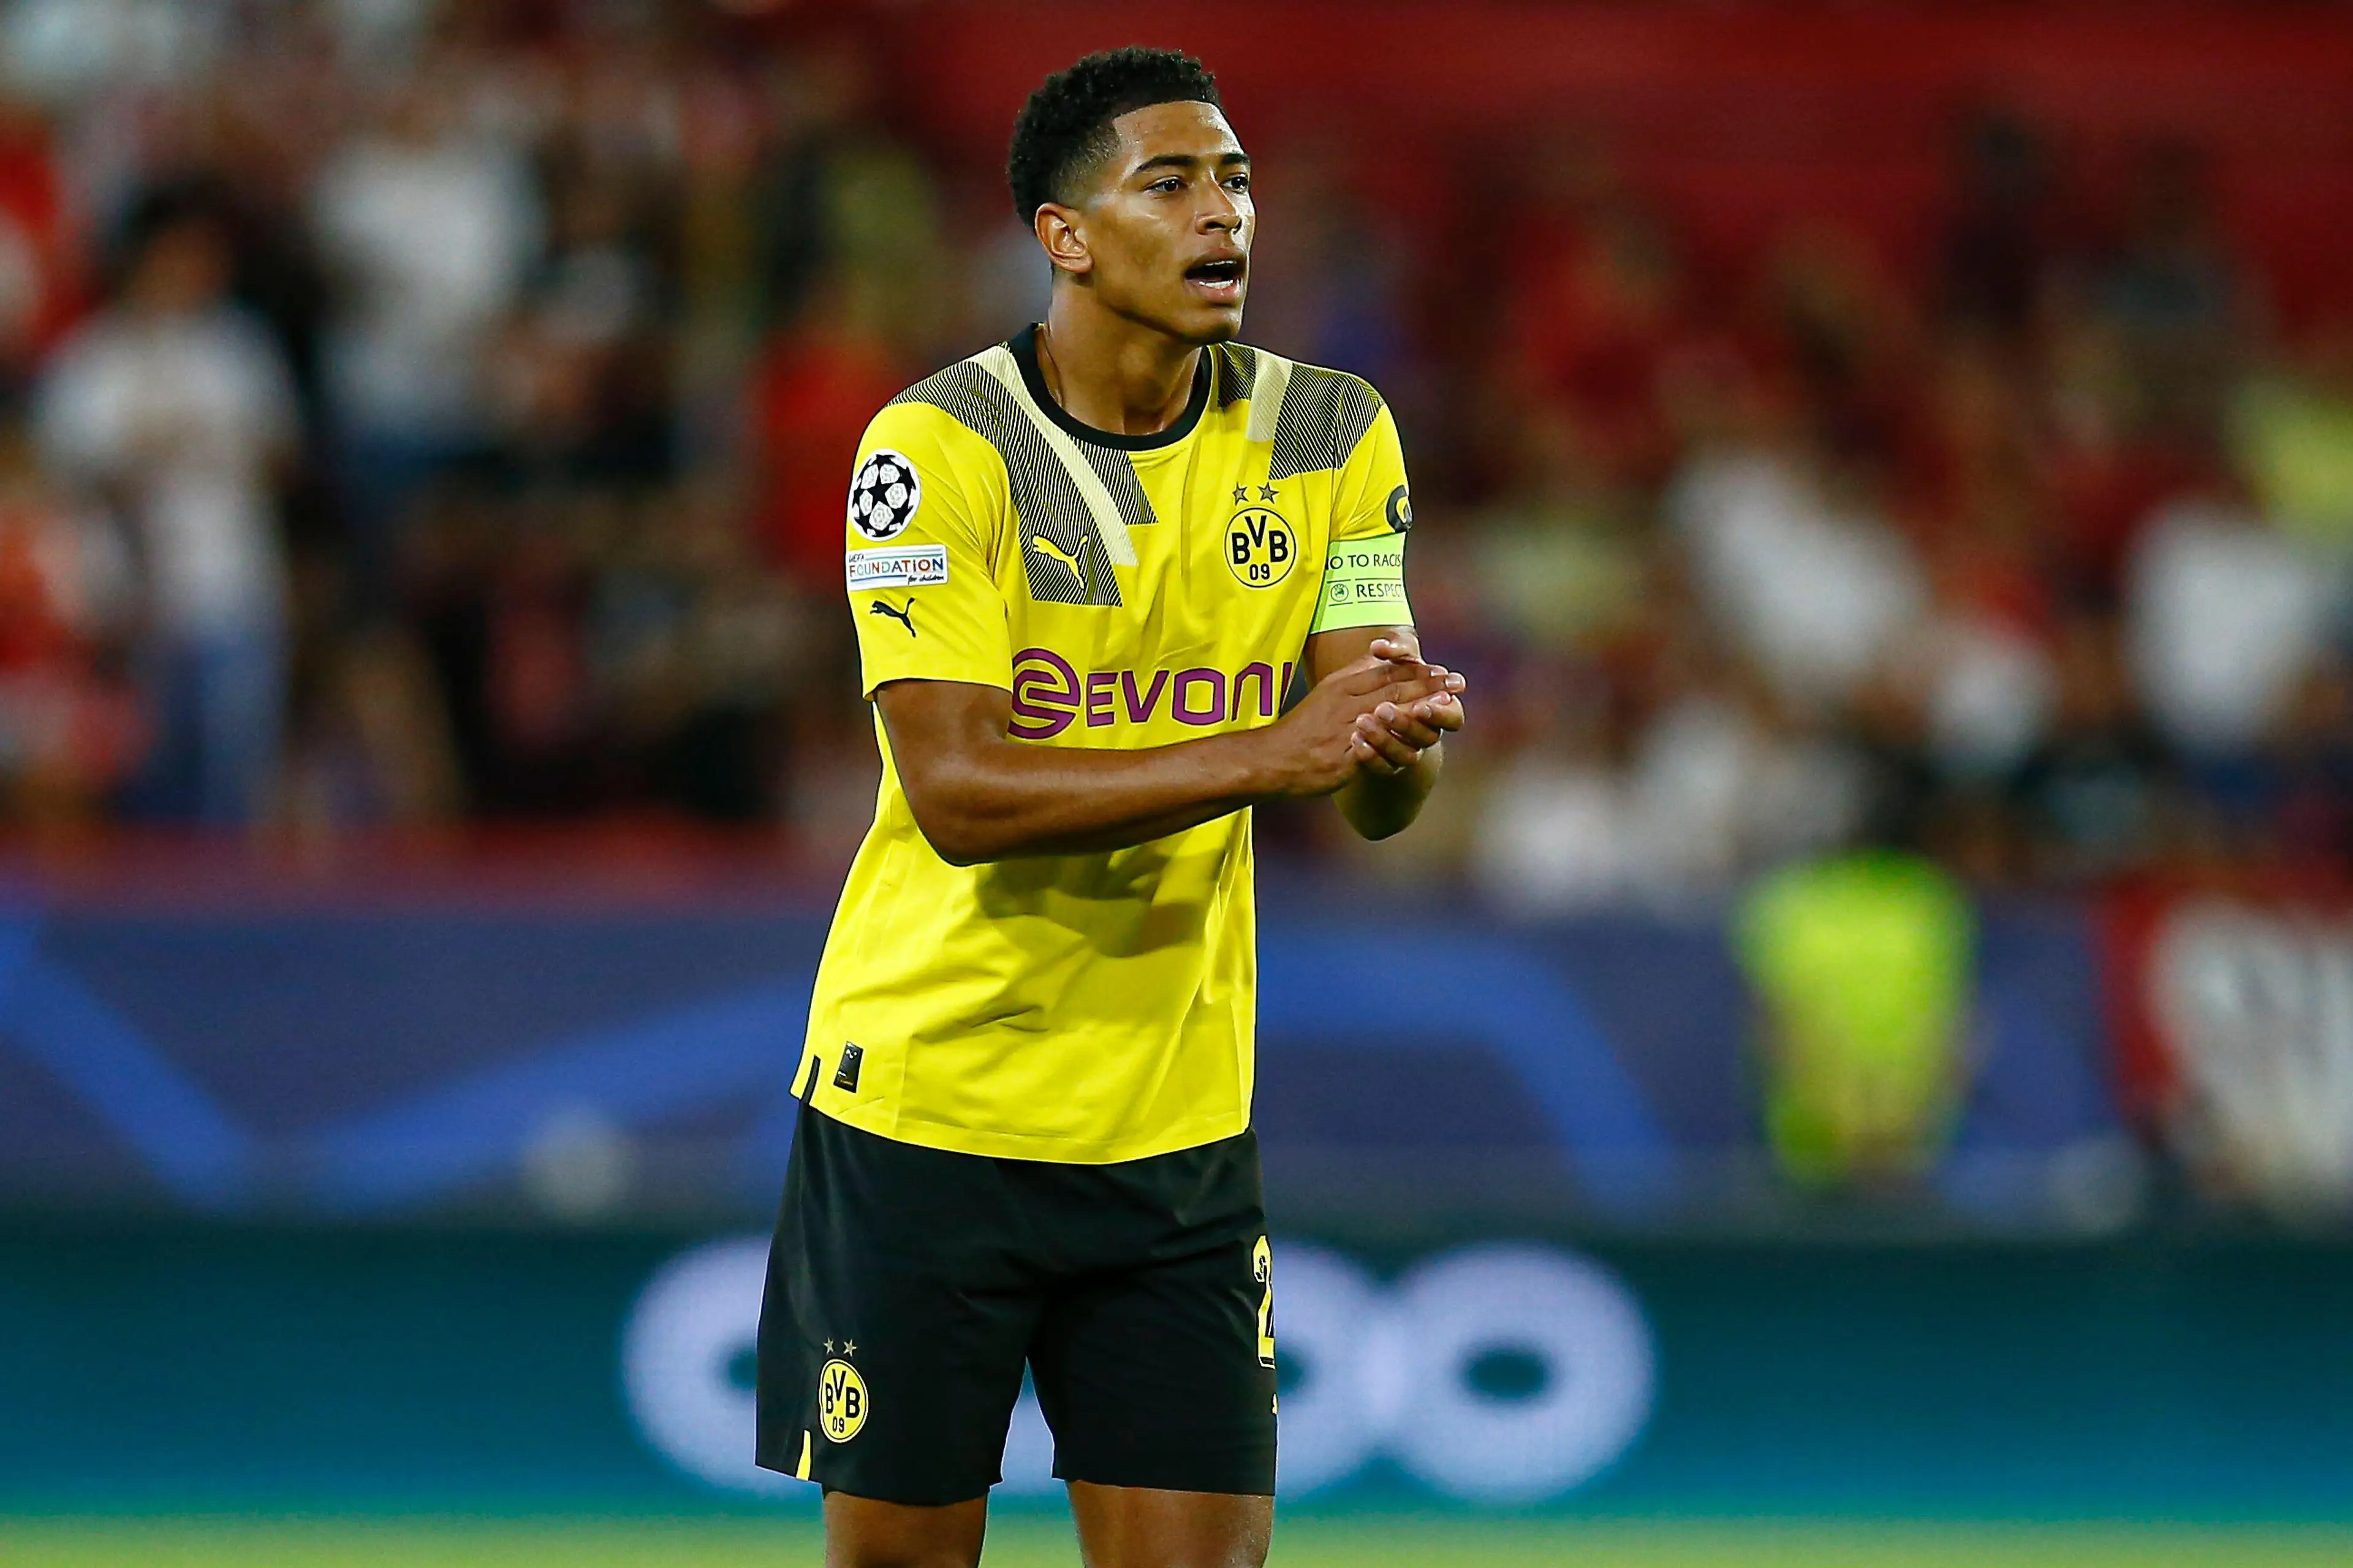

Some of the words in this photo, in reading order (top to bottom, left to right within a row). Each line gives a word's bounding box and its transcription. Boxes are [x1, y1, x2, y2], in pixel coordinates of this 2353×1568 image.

[1231, 515, 1289, 564] BVB
[849, 558, 944, 577] FOUNDATION
[1347, 554, 1370, 567] TO
[1249, 563, 1270, 580] 09
[907, 575, 918, 586] for
[825, 1368, 861, 1418] BVB
[832, 1416, 845, 1433] 09
